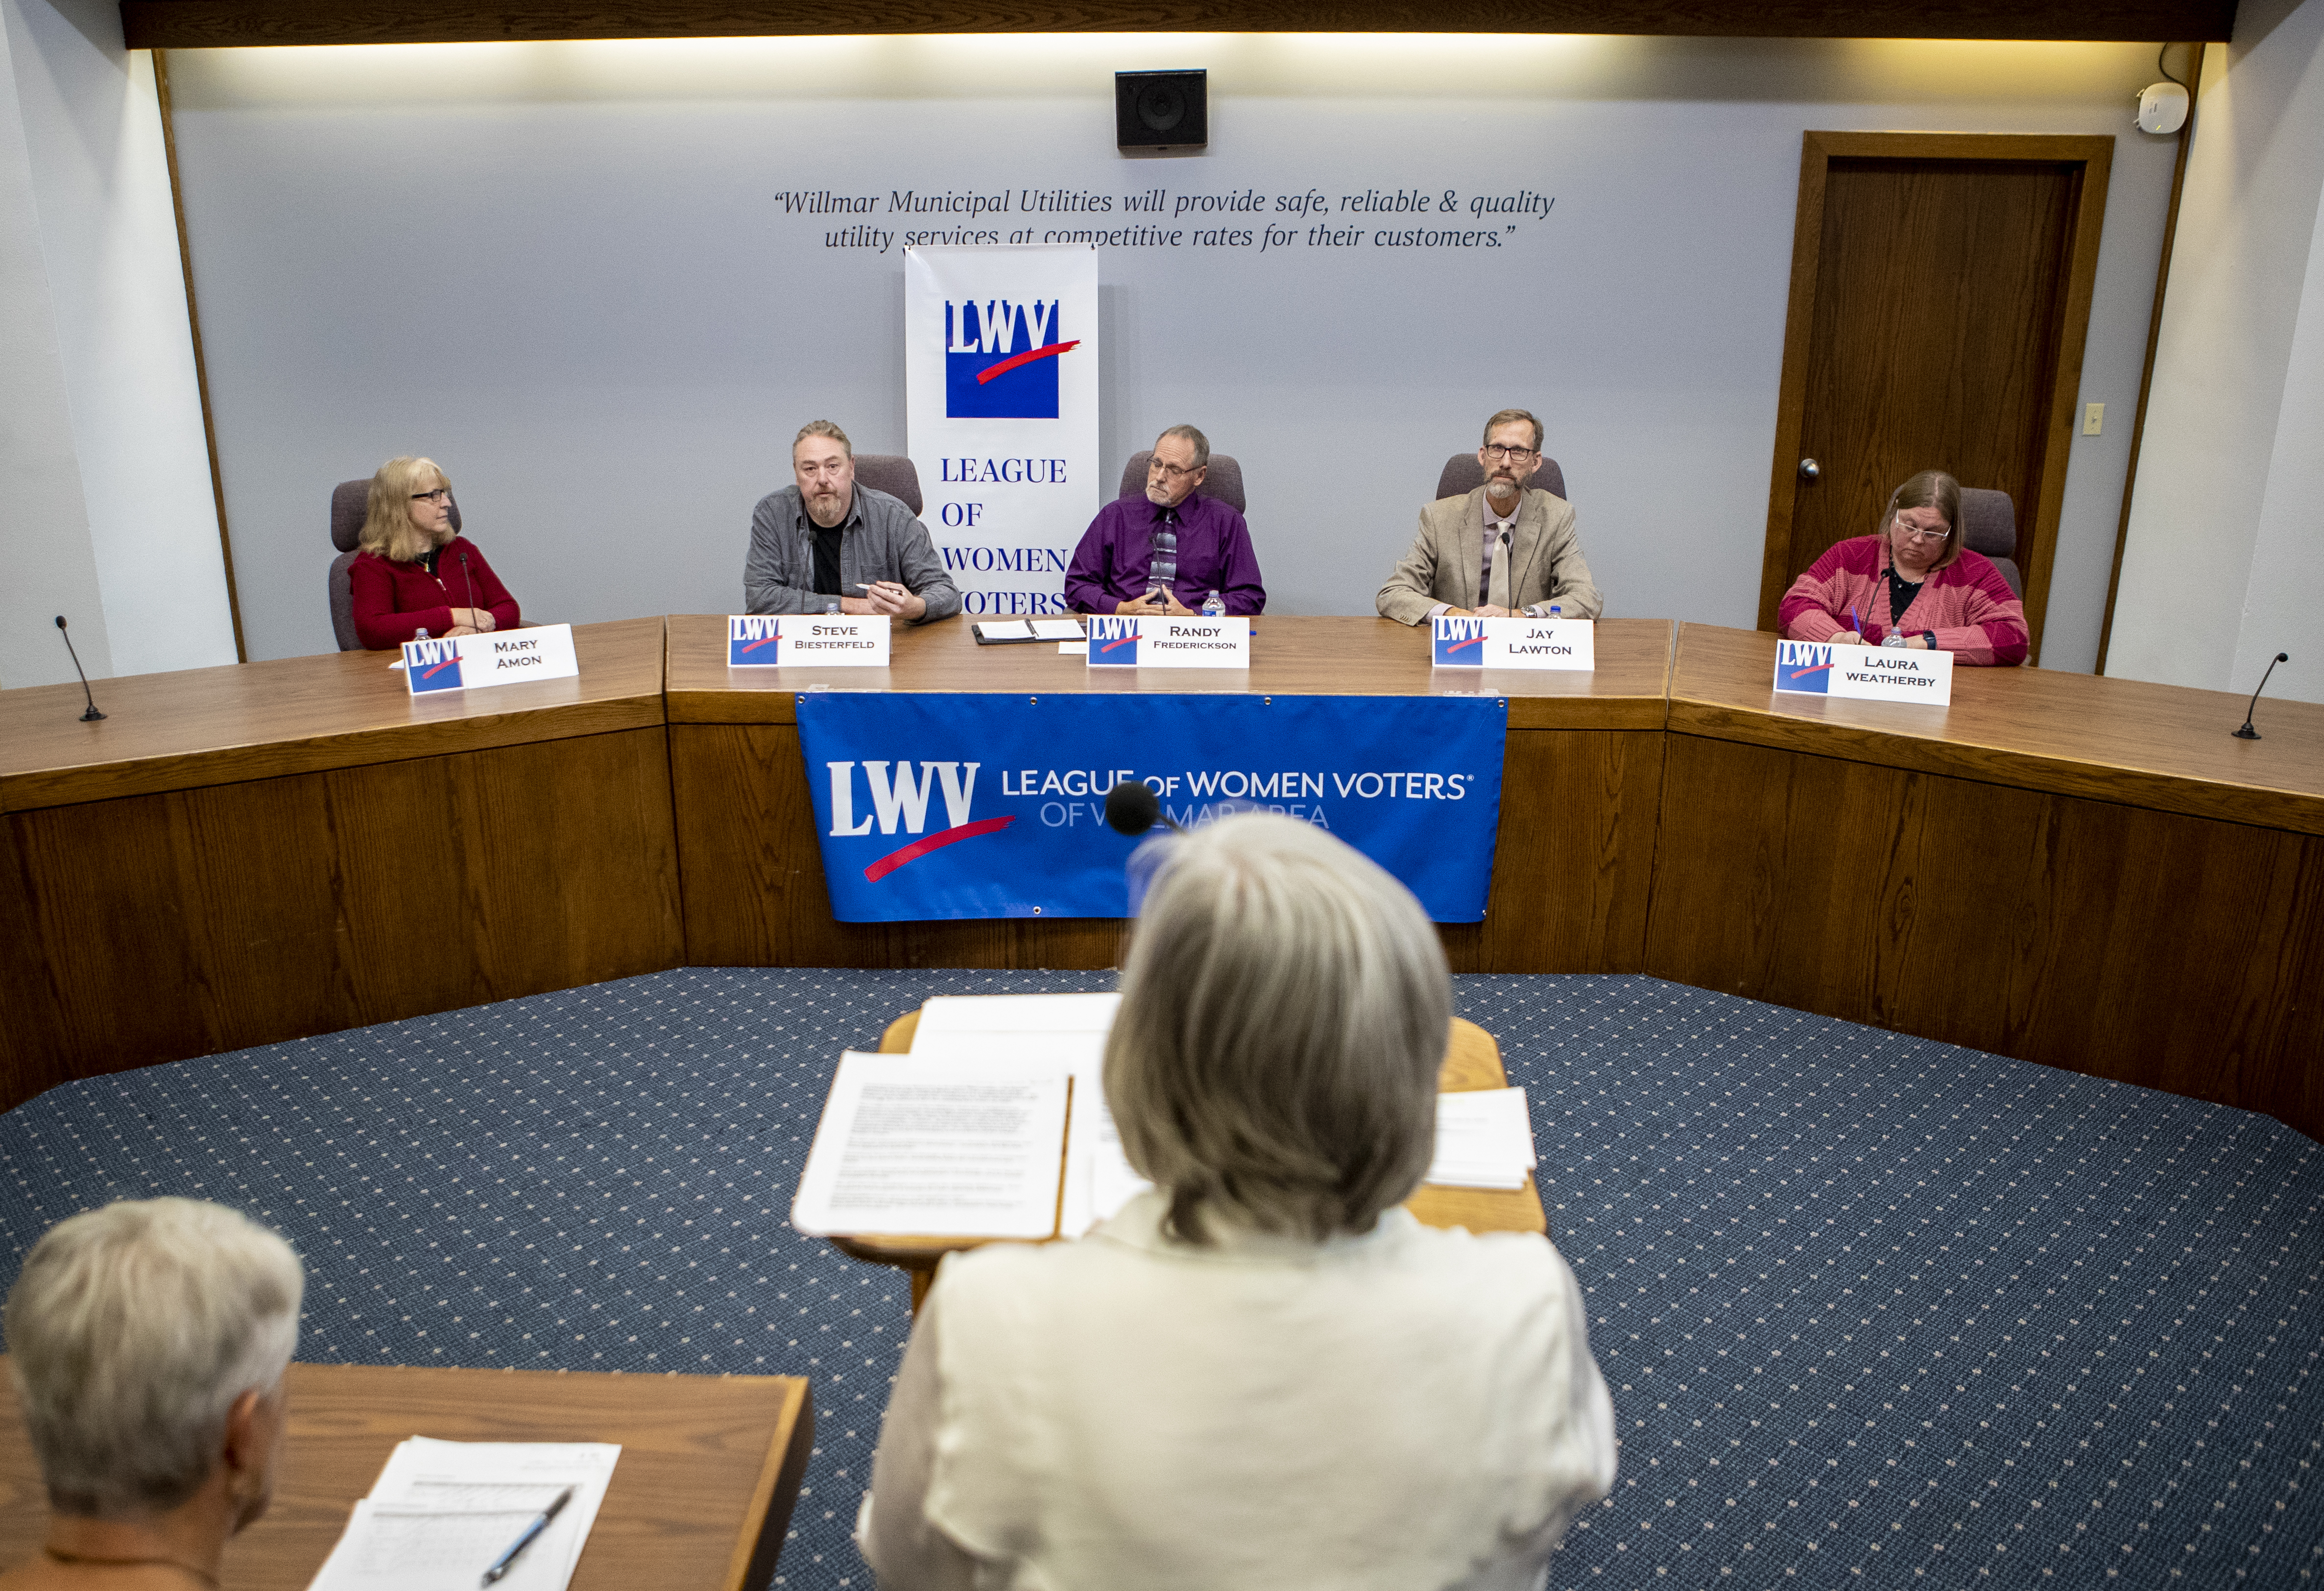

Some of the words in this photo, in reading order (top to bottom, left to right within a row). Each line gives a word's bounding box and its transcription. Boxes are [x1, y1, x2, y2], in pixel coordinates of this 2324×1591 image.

[888, 190, 1010, 218] Municipal
[1021, 190, 1112, 212] Utilities
[1124, 189, 1166, 212] will
[1174, 189, 1265, 218] provide
[1275, 189, 1329, 218] safe,
[1340, 189, 1431, 213] reliable
[1439, 190, 1459, 212] &
[1470, 190, 1556, 220] quality
[825, 225, 894, 254] utility
[902, 225, 999, 246] services
[1009, 227, 1034, 244] at
[1044, 225, 1183, 246] competitive
[1193, 227, 1253, 246] rates
[1260, 223, 1298, 253] for
[1308, 224, 1365, 246] their
[948, 299, 1058, 354] LWV
[941, 458, 1067, 483] LEAGUE
[941, 503, 983, 527] OF
[941, 547, 1068, 573] WOMEN
[960, 591, 1065, 615] OTERS
[732, 618, 779, 641] LWV
[812, 625, 858, 636] STEVE
[1091, 617, 1138, 640] LWV
[1170, 626, 1222, 637] RANDY
[1436, 618, 1483, 641] LWV
[1526, 628, 1554, 639] JAY
[407, 639, 457, 667] LWV
[494, 639, 538, 653] MARY
[794, 640, 875, 650] BIESTERFELD
[1153, 640, 1237, 650] FREDERICKSON
[1509, 643, 1572, 655] LAWTON
[1780, 642, 1832, 667] LWV
[497, 655, 542, 669] AMON
[1864, 656, 1919, 671] LAURA
[1845, 672, 1936, 687] WEATHERBY
[1143, 775, 1180, 797] OF
[1186, 771, 1323, 798] WOMEN
[827, 760, 981, 836] LWV
[1040, 801, 1085, 827] OF
